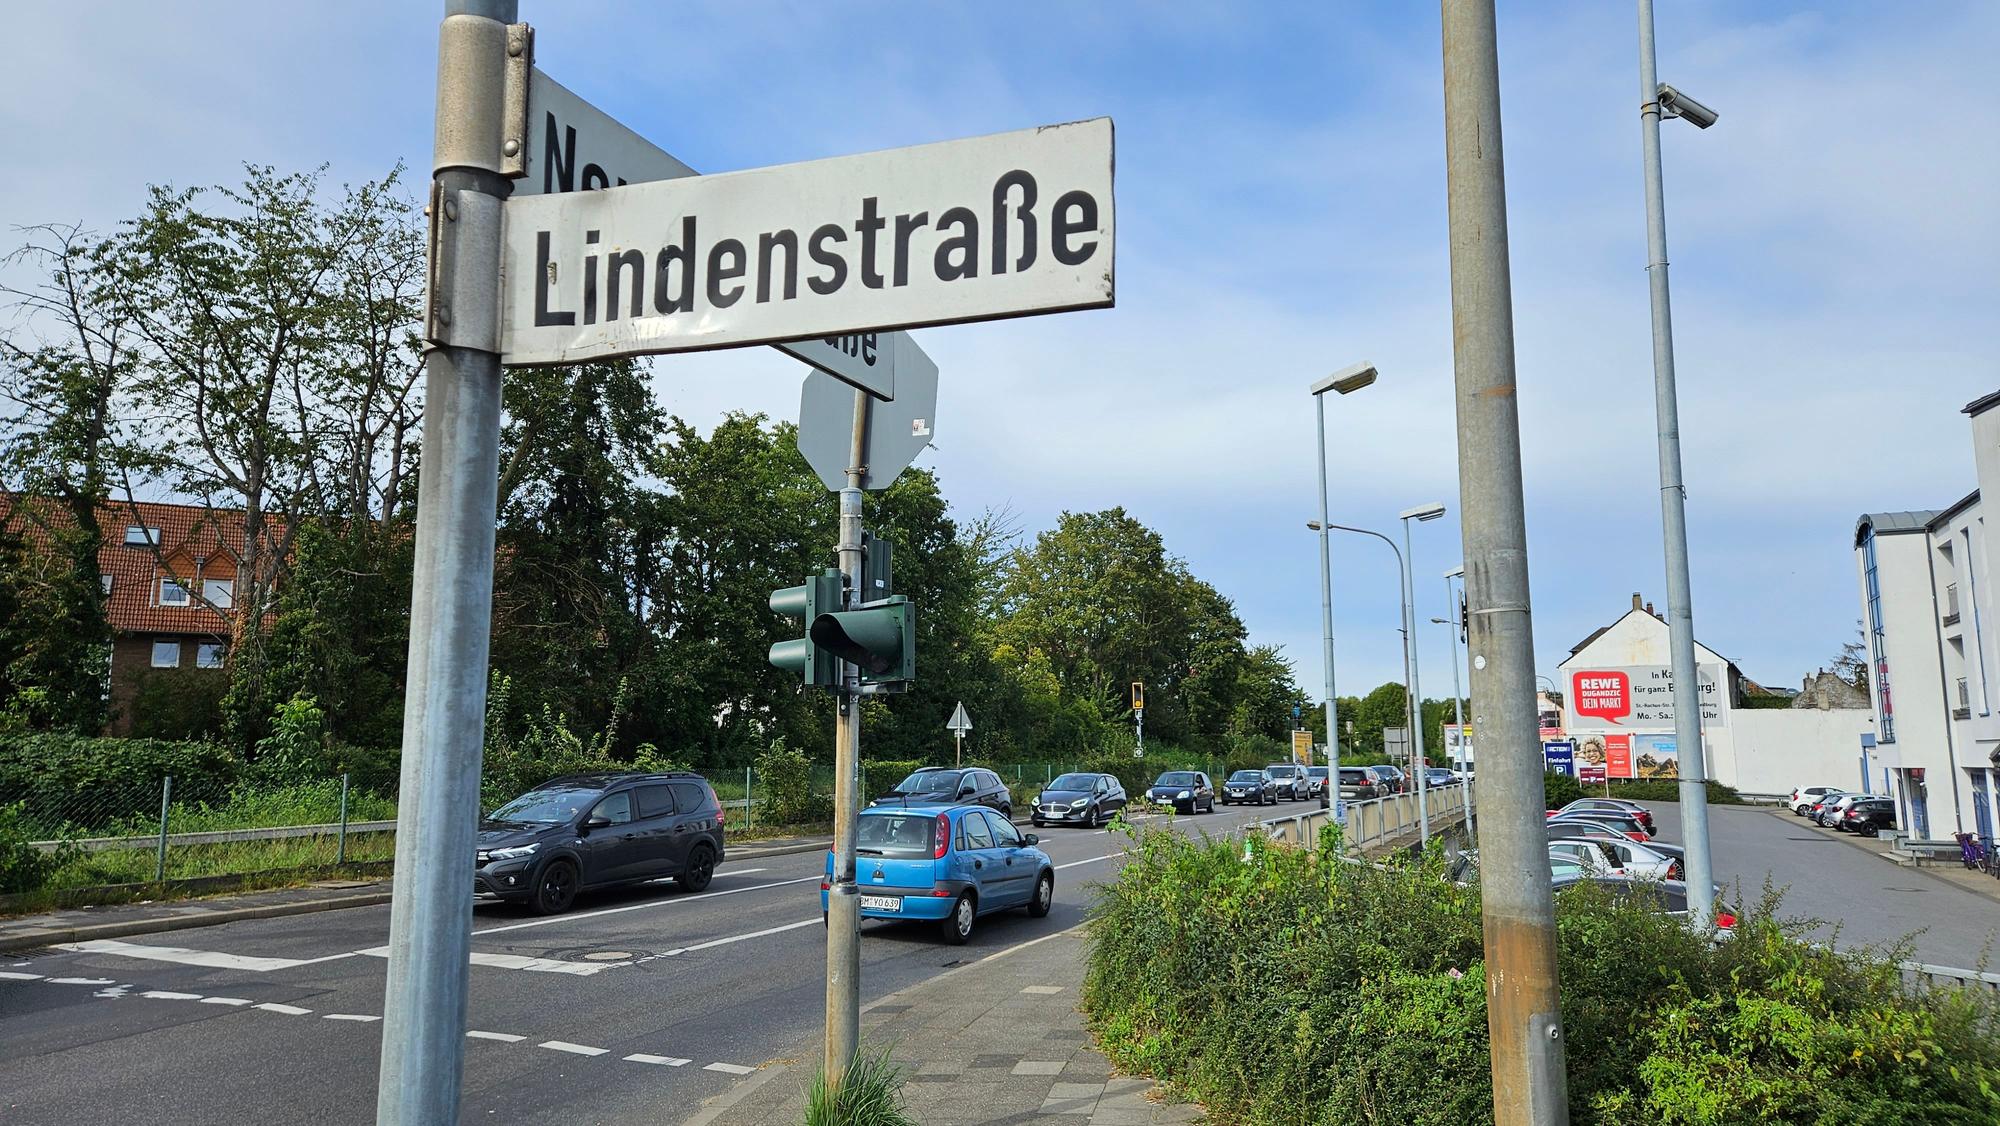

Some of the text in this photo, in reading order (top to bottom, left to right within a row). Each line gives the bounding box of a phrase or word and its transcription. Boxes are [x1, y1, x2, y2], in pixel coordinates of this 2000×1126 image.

[534, 169, 1099, 327] Lindenstraße
[1661, 669, 1673, 679] Ka
[1581, 678, 1621, 689] REWE
[1634, 685, 1646, 693] für
[1647, 687, 1666, 695] ganz
[1582, 697, 1621, 709] DEIN MARKT
[1637, 712, 1652, 720] Mo.
[1703, 711, 1718, 719] Uhr
[1556, 766, 1564, 775] P
[884, 899, 899, 908] 639
